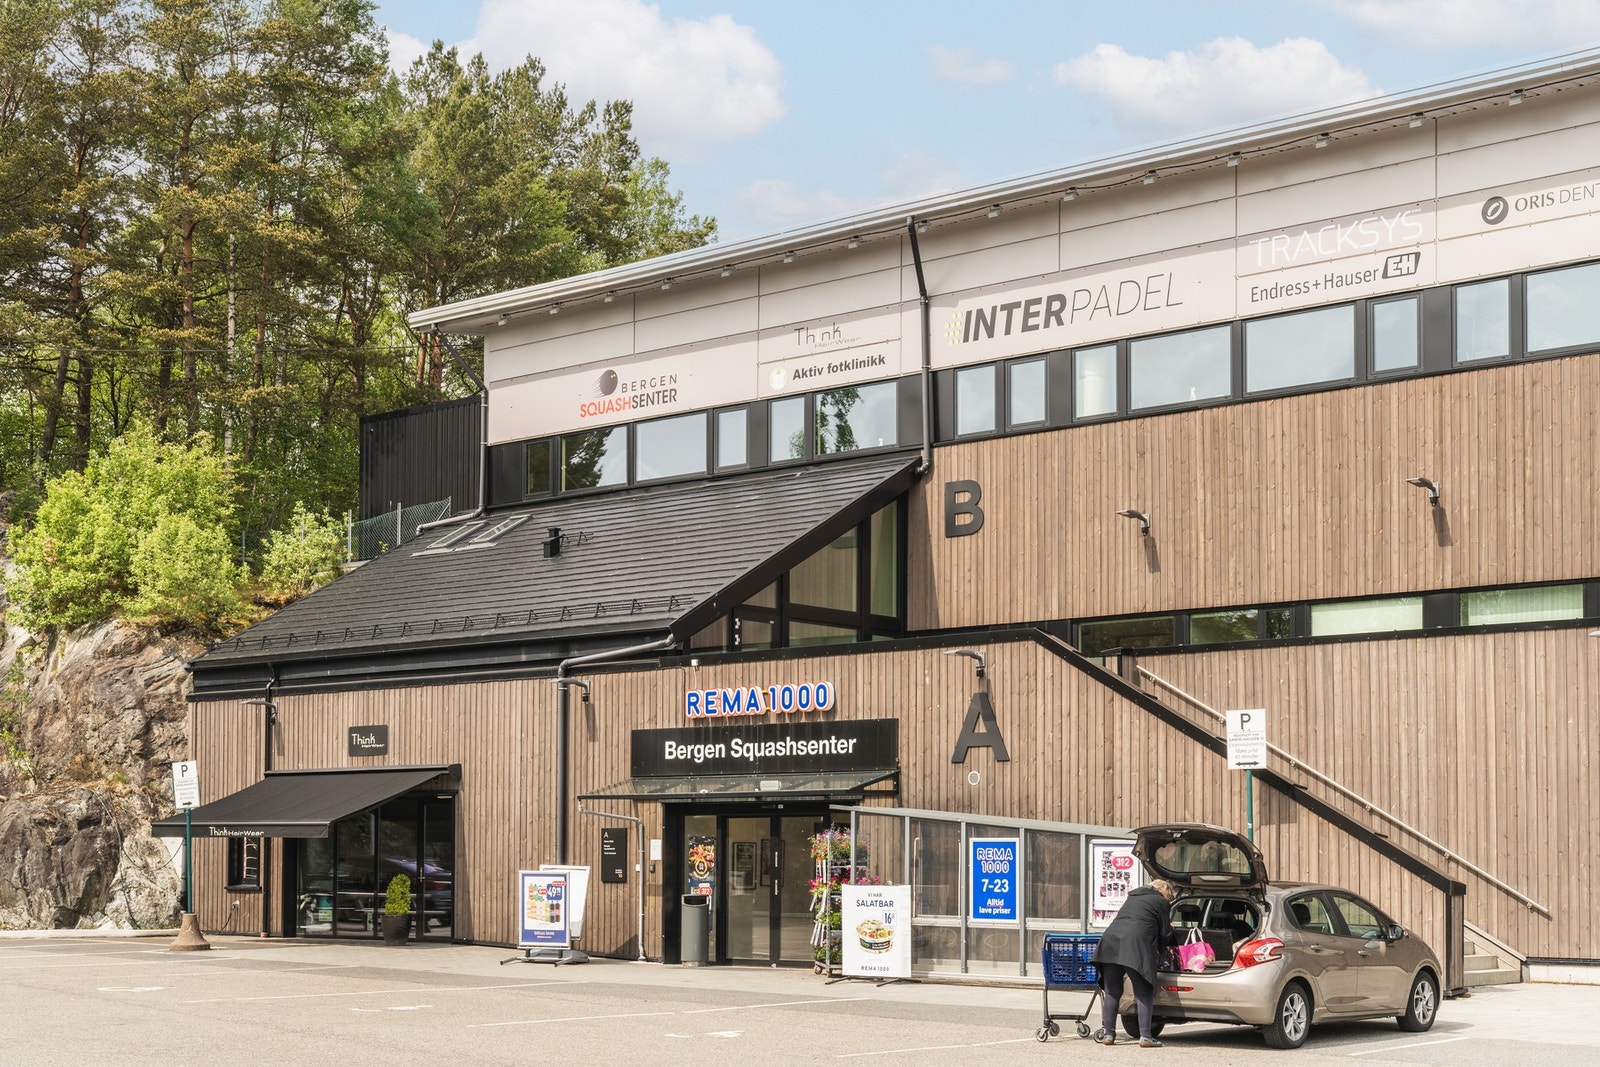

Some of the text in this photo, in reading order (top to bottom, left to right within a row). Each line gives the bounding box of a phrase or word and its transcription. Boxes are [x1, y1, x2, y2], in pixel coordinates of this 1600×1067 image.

[1515, 192, 1555, 212] ORIS
[1250, 208, 1423, 267] TRACKSYS
[792, 354, 886, 381] Aktiv fotklinikk
[621, 374, 678, 393] BERGEN
[580, 388, 678, 418] SQUASHSENTER
[945, 479, 985, 539] B
[686, 681, 830, 718] REMA 1000
[951, 692, 1011, 764] A
[1240, 713, 1251, 729] P
[351, 732, 376, 745] Think
[664, 735, 857, 763] Bergen Squashsenter
[181, 764, 188, 777] P
[209, 826, 228, 837] Think
[976, 847, 1014, 861] REMA
[981, 860, 1010, 874] 1000
[981, 878, 1010, 893] 7-23
[856, 899, 894, 908] SALATBAR
[986, 898, 1005, 907] Alltid
[978, 906, 1012, 916] lave priser
